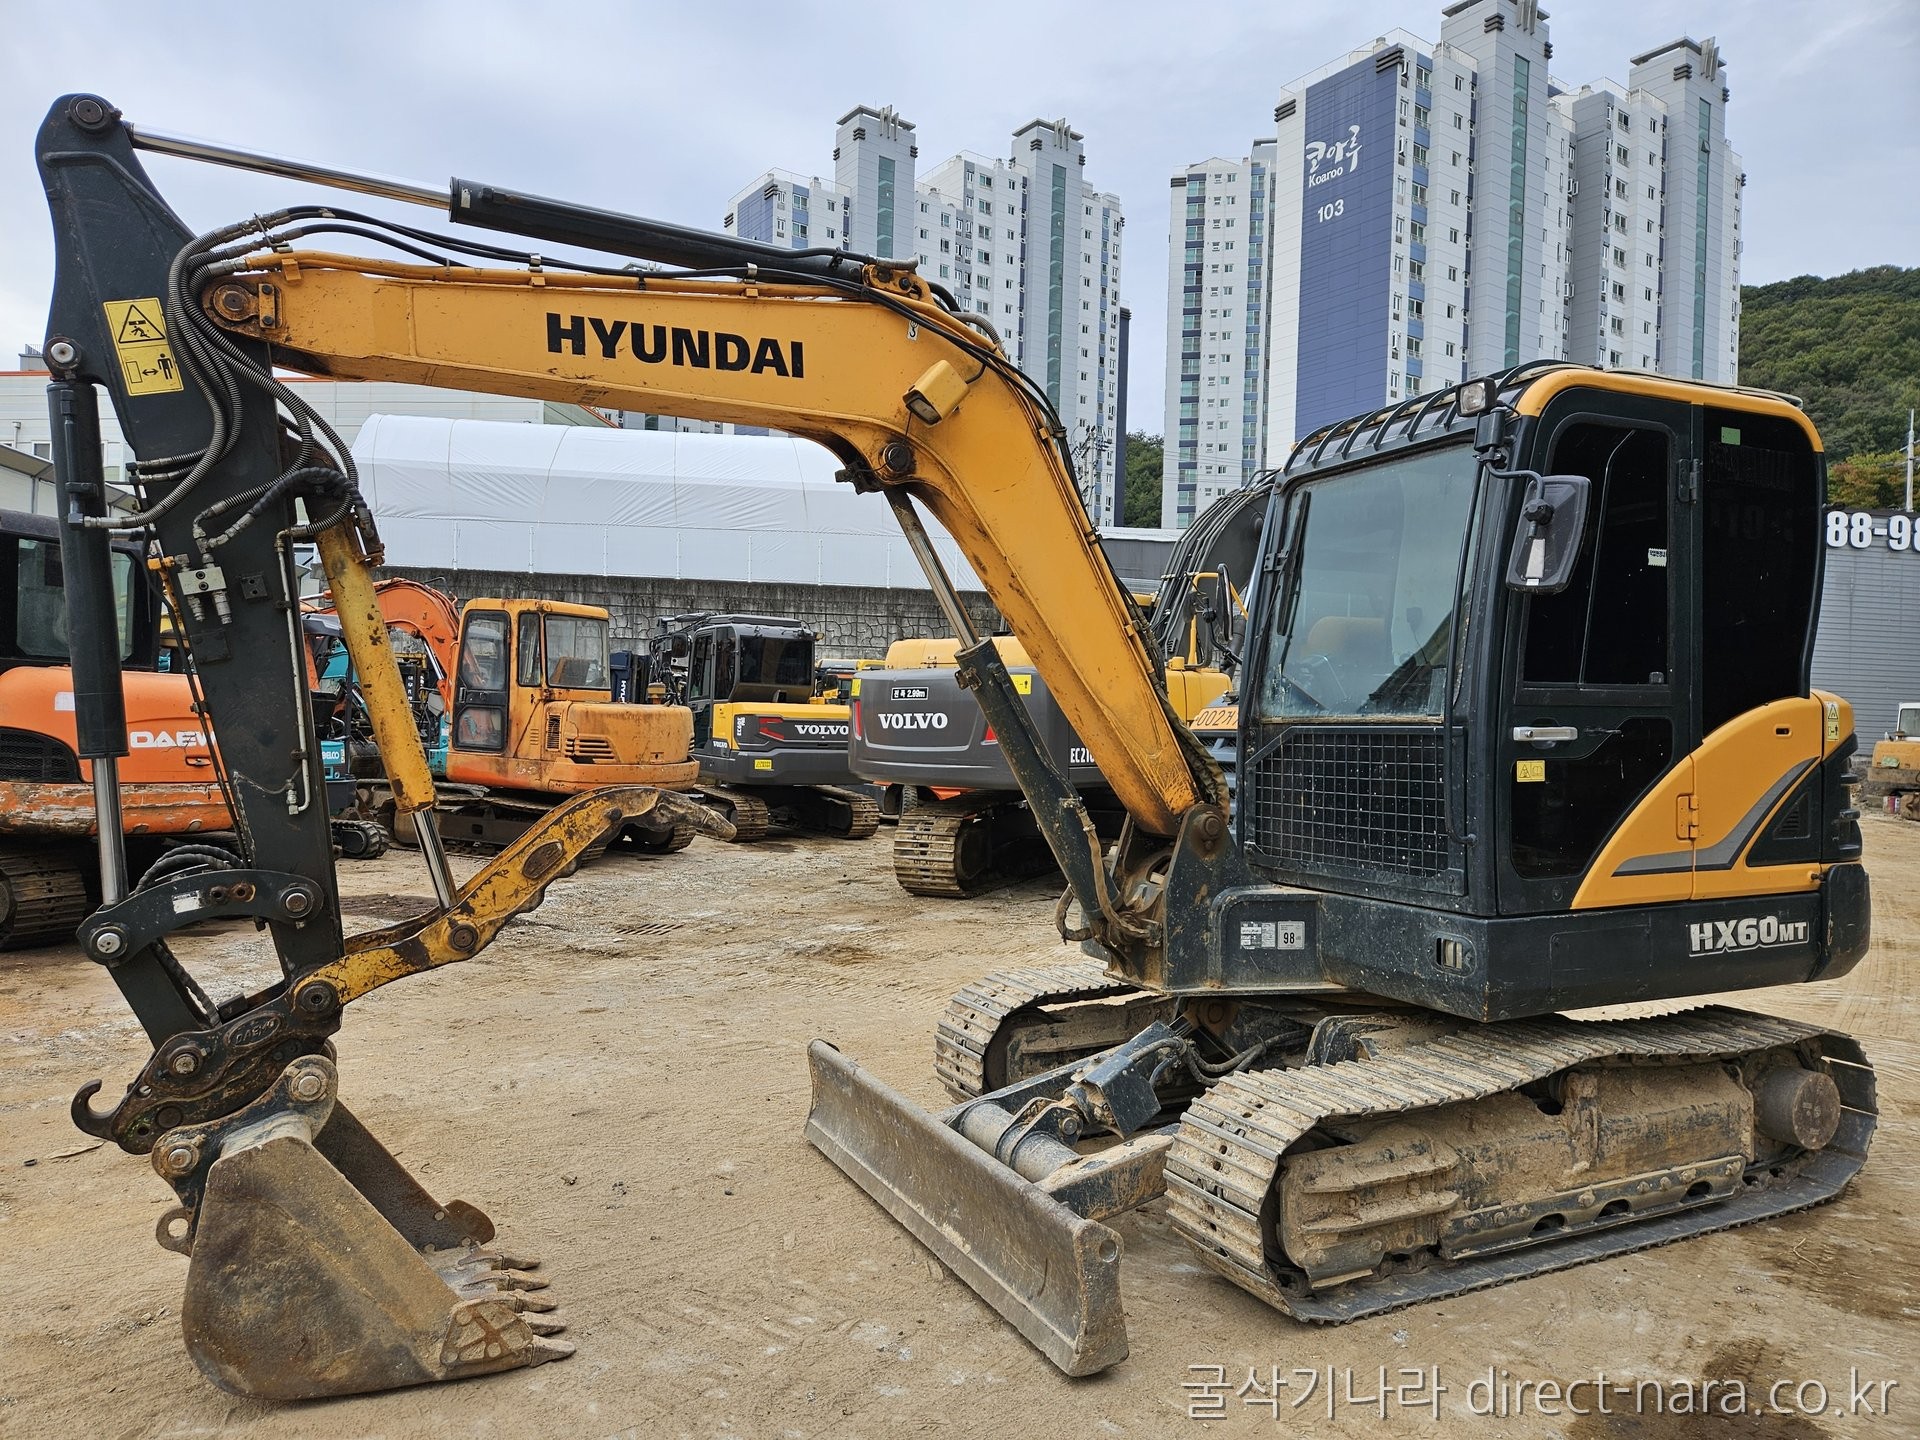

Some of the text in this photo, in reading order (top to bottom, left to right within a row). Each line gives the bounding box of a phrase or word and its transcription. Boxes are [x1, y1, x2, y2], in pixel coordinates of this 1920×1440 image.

[1308, 166, 1344, 189] Koaroo
[1317, 198, 1344, 223] 103
[546, 312, 804, 379] HYUNDAI
[795, 724, 849, 735] VOLVO
[878, 713, 948, 729] VOLVO
[1283, 932, 1295, 944] 98
[1690, 915, 1807, 952] HX60MT
